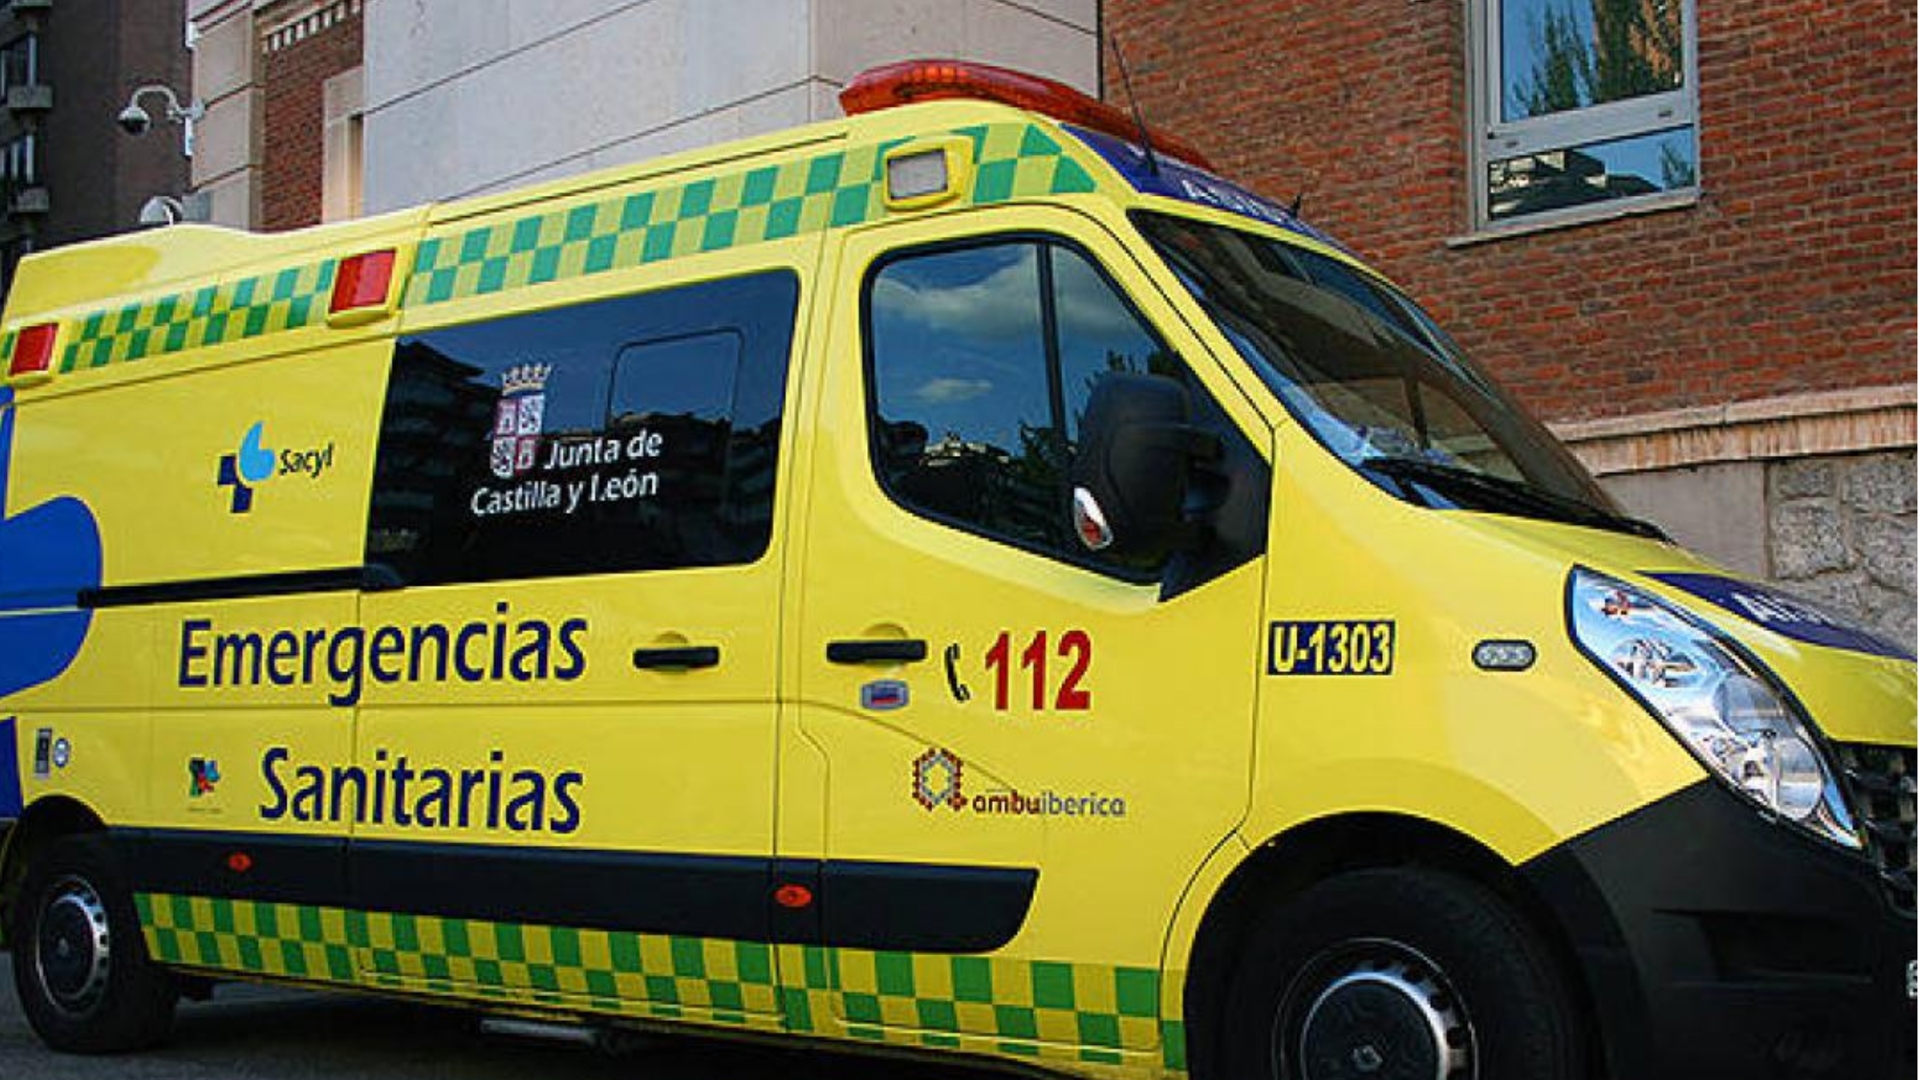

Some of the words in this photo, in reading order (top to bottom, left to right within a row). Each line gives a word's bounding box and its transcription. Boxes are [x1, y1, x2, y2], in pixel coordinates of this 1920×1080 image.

[279, 441, 333, 478] Sacyl
[543, 437, 621, 470] Junta
[627, 428, 663, 459] de
[470, 480, 561, 516] Castilla
[566, 482, 583, 514] y
[590, 468, 659, 502] León
[178, 602, 588, 706] Emergencias
[984, 630, 1092, 711] 112
[1272, 624, 1393, 674] U-1303
[259, 748, 583, 833] Sanitarias
[972, 789, 1126, 815] ambuiberica
